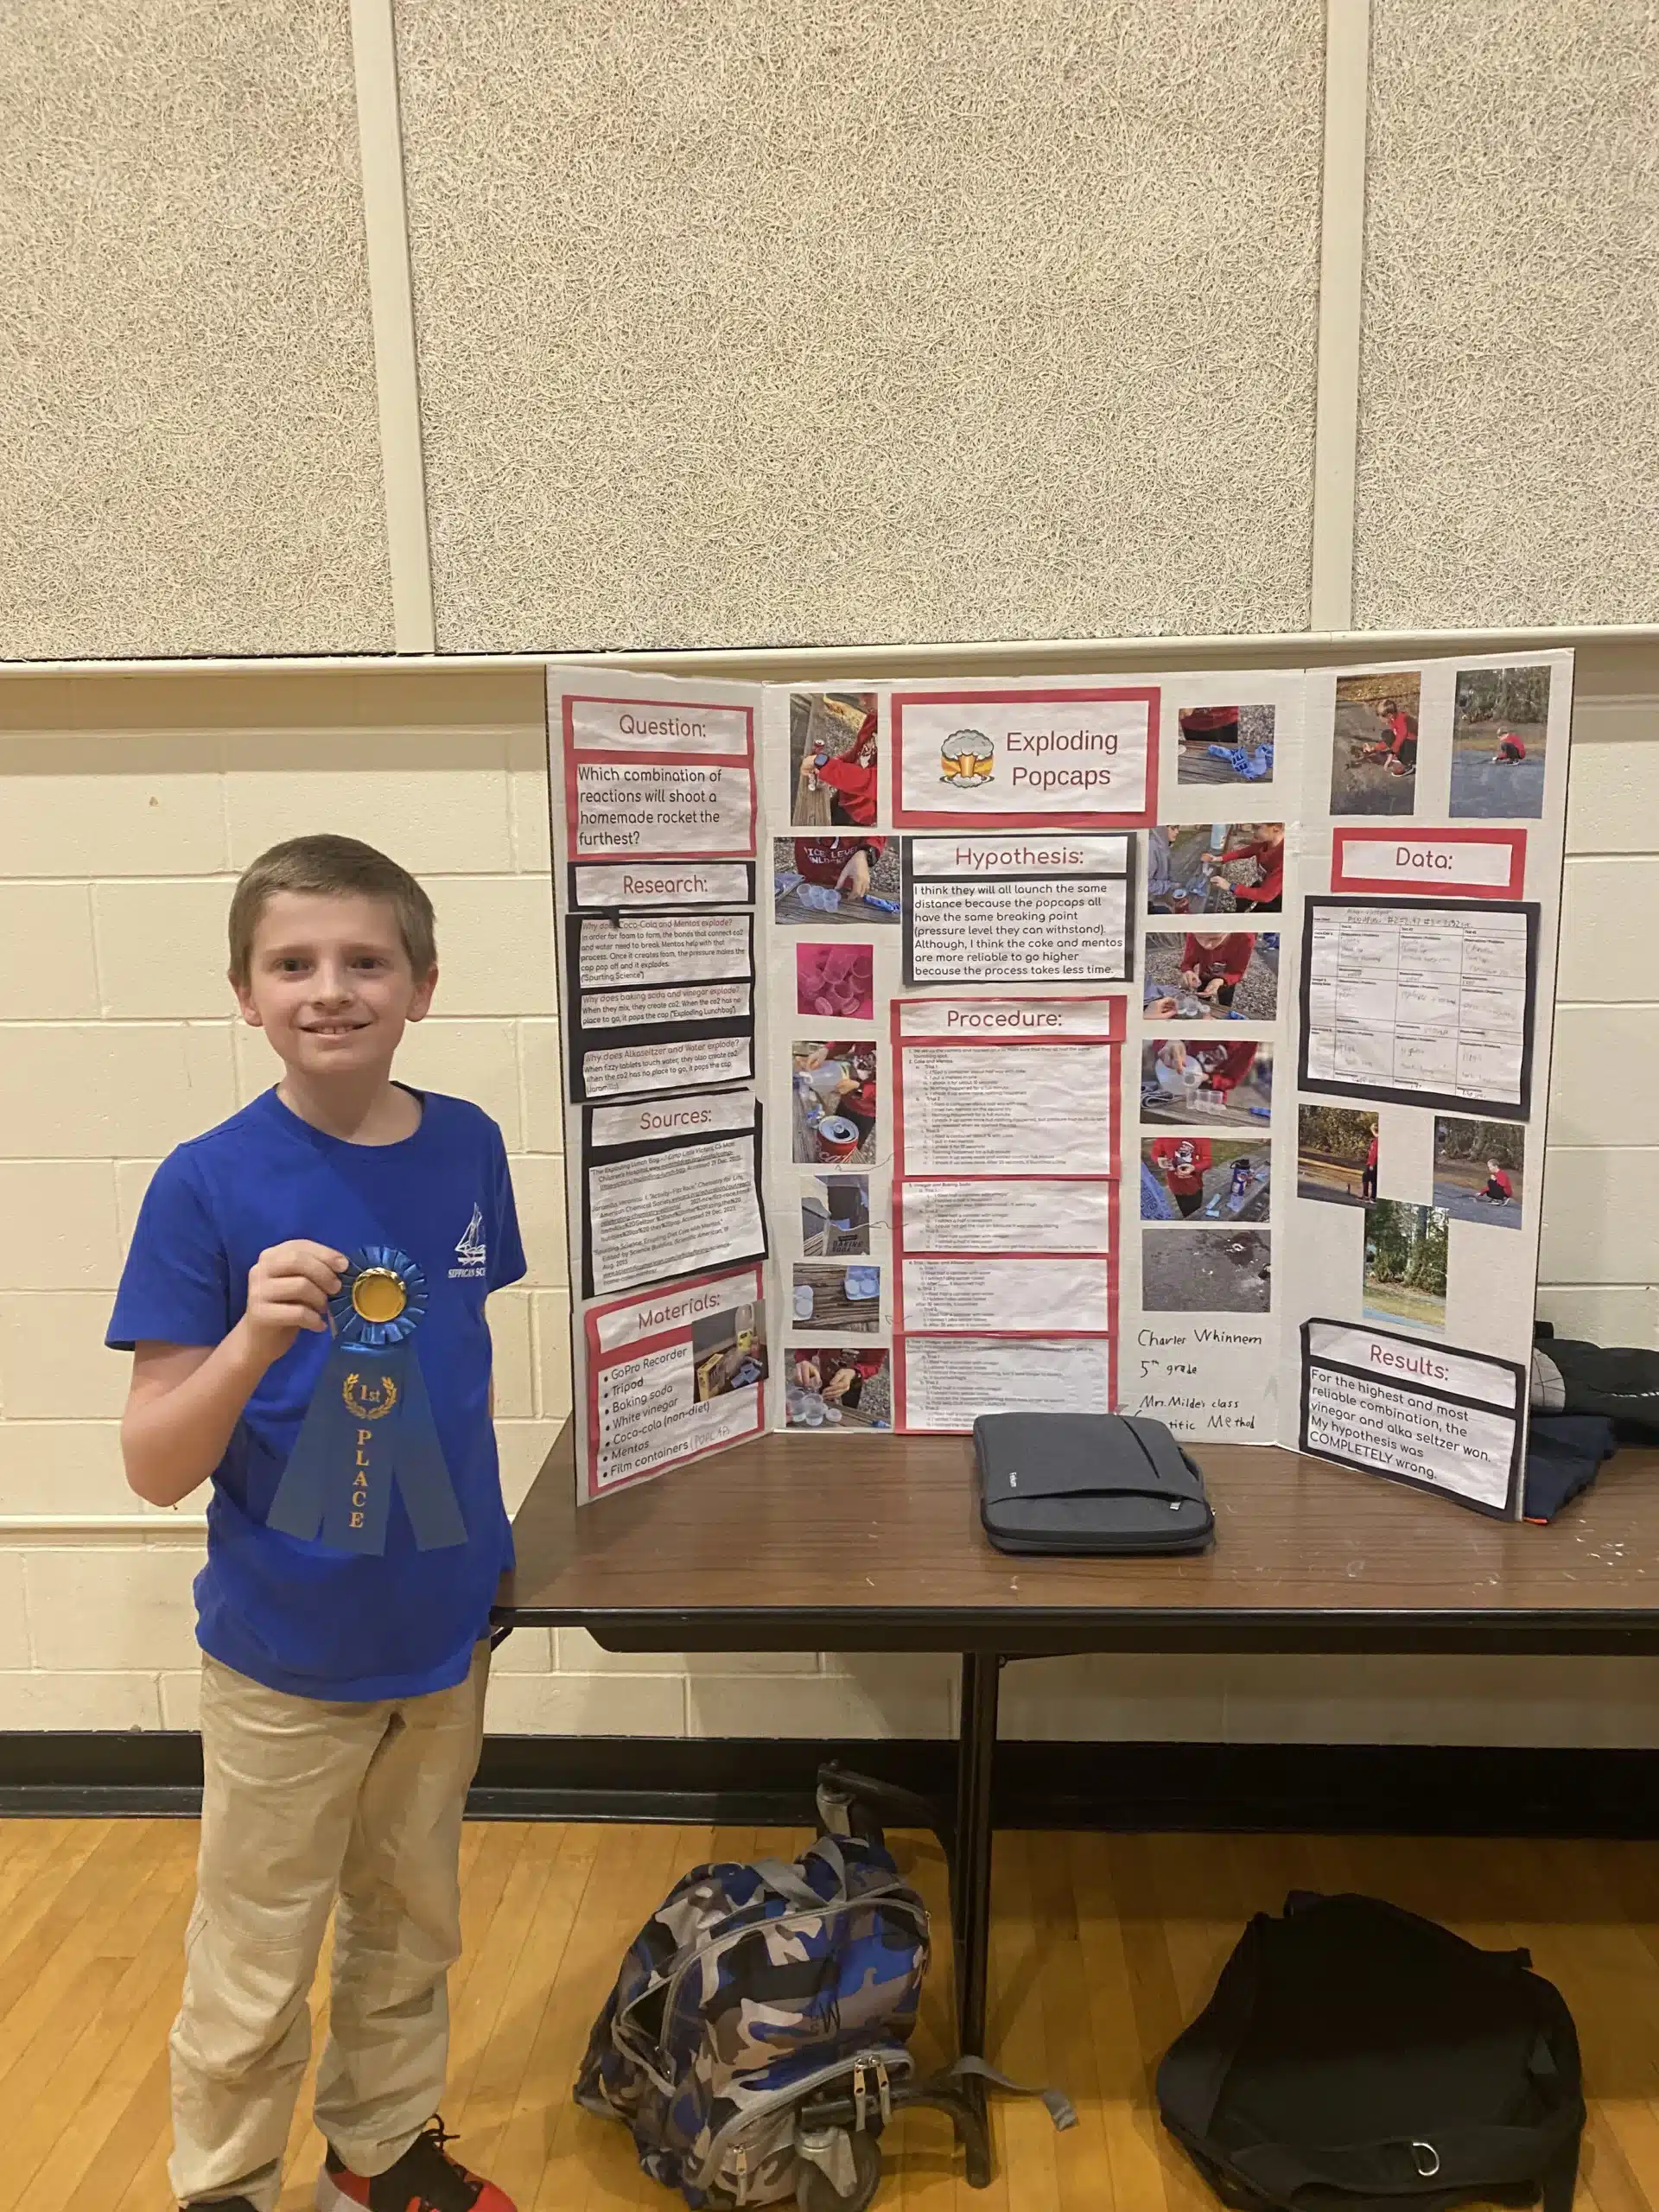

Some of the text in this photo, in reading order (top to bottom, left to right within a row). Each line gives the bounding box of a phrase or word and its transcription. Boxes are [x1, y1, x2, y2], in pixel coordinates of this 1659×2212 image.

[619, 714, 706, 738] Question:
[1006, 730, 1118, 756] Exploding
[578, 766, 722, 782] Which combination of
[1012, 766, 1111, 791] Popcaps
[580, 790, 717, 804] reactions will shoot a
[580, 810, 720, 824] homemade rocket the
[579, 831, 640, 846] furthest?
[955, 847, 1084, 870] Hypothesis:
[1395, 847, 1453, 870] Data:
[623, 874, 709, 894] Research:
[920, 886, 948, 894] think
[951, 886, 976, 897] they
[977, 885, 995, 894] will
[998, 884, 1012, 893] all
[1014, 884, 1052, 894] launch
[1056, 884, 1074, 893] the
[914, 897, 1102, 910] distance because the popcaps all
[582, 922, 598, 931] Why
[658, 919, 672, 928] and
[702, 918, 733, 928] explode?
[914, 913, 940, 923] have
[943, 912, 962, 922] the
[996, 912, 1046, 923] breaking
[1048, 911, 1078, 923] point
[913, 925, 965, 938] (pressure
[968, 925, 994, 935] level
[995, 925, 1020, 937] they
[1046, 925, 1107, 935] withstand).
[914, 939, 968, 950] Although,
[976, 939, 1004, 949] think
[1007, 938, 1026, 949] the
[1027, 938, 1053, 948] coke
[1056, 938, 1078, 948] and
[1081, 938, 1123, 948] mentos
[915, 951, 1079, 964] are more reliable to go higher
[915, 964, 1114, 977] because the process takes less time.
[583, 995, 599, 1004] Why
[600, 994, 619, 1002] does
[648, 991, 665, 1000] soda
[947, 1010, 1063, 1027] Procedure:
[603, 1052, 622, 1060] does
[668, 1046, 683, 1054] and
[639, 1109, 712, 1130] Sources:
[639, 1294, 721, 1330] Materials:
[611, 1347, 688, 1381] GoPro Recorder
[1166, 1363, 1198, 1376] grade
[1370, 1344, 1449, 1381] Results:
[360, 1384, 380, 1402] 1st
[612, 1378, 644, 1397] Tripod
[1311, 1370, 1469, 1421] For the highest and most
[613, 1384, 673, 1414] Baking soda
[1211, 1398, 1239, 1408] class
[613, 1398, 678, 1429] White vinegar
[1312, 1386, 1468, 1438] reliable combination, the
[613, 1402, 710, 1446] Coca-cola (non-diet)
[1311, 1402, 1491, 1463] vinegar and alka seltzer won.
[1311, 1415, 1424, 1458] My hypothesis was
[611, 1440, 649, 1459] Mentos
[1310, 1431, 1438, 1480] COMPLETELY wrong.
[610, 1442, 689, 1477] Film containers
[349, 1428, 372, 1529] PLACE
